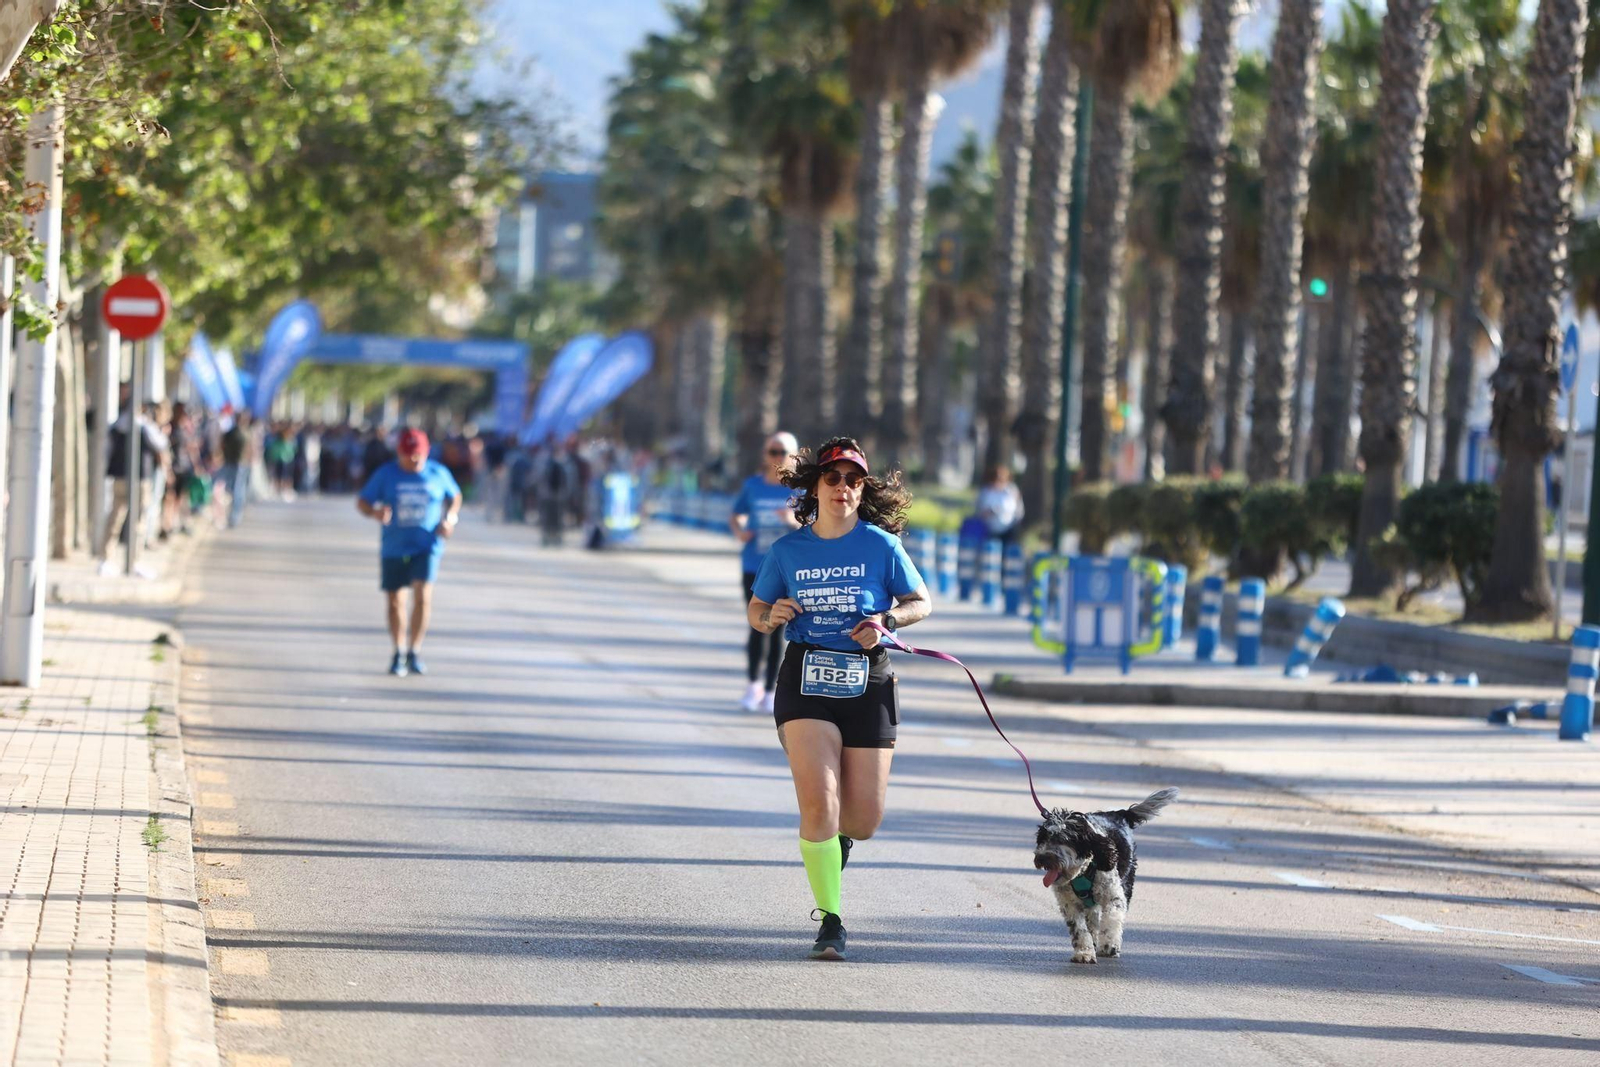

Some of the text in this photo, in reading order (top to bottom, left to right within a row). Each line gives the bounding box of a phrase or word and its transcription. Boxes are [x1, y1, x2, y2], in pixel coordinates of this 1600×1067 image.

[796, 563, 866, 581] mayoral
[797, 586, 861, 598] RUNNING
[803, 595, 856, 605] MAKES
[811, 667, 860, 684] 1525
